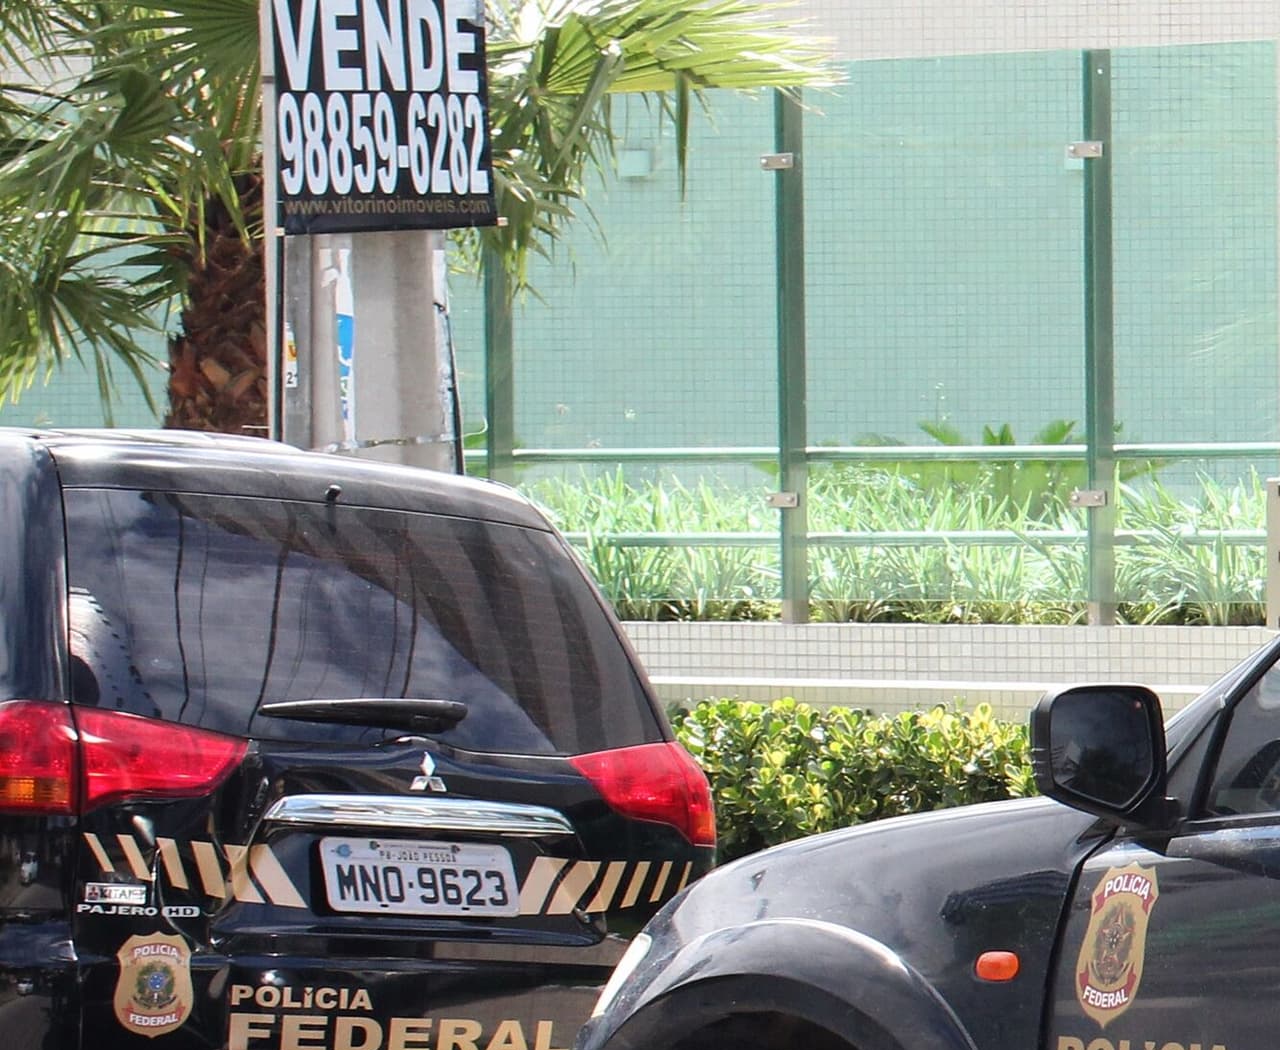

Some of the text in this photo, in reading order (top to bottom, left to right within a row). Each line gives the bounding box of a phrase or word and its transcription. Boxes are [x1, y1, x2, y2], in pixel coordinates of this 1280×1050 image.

[274, 0, 480, 93] VENDE
[278, 91, 490, 195] 98859-6282
[1104, 874, 1151, 900] POLÍCIA
[76, 903, 195, 917] PAJERO HD
[231, 984, 373, 1011] POLÍCIA
[1082, 985, 1129, 1009] FEDERAL
[129, 1013, 179, 1027] FEDERAL
